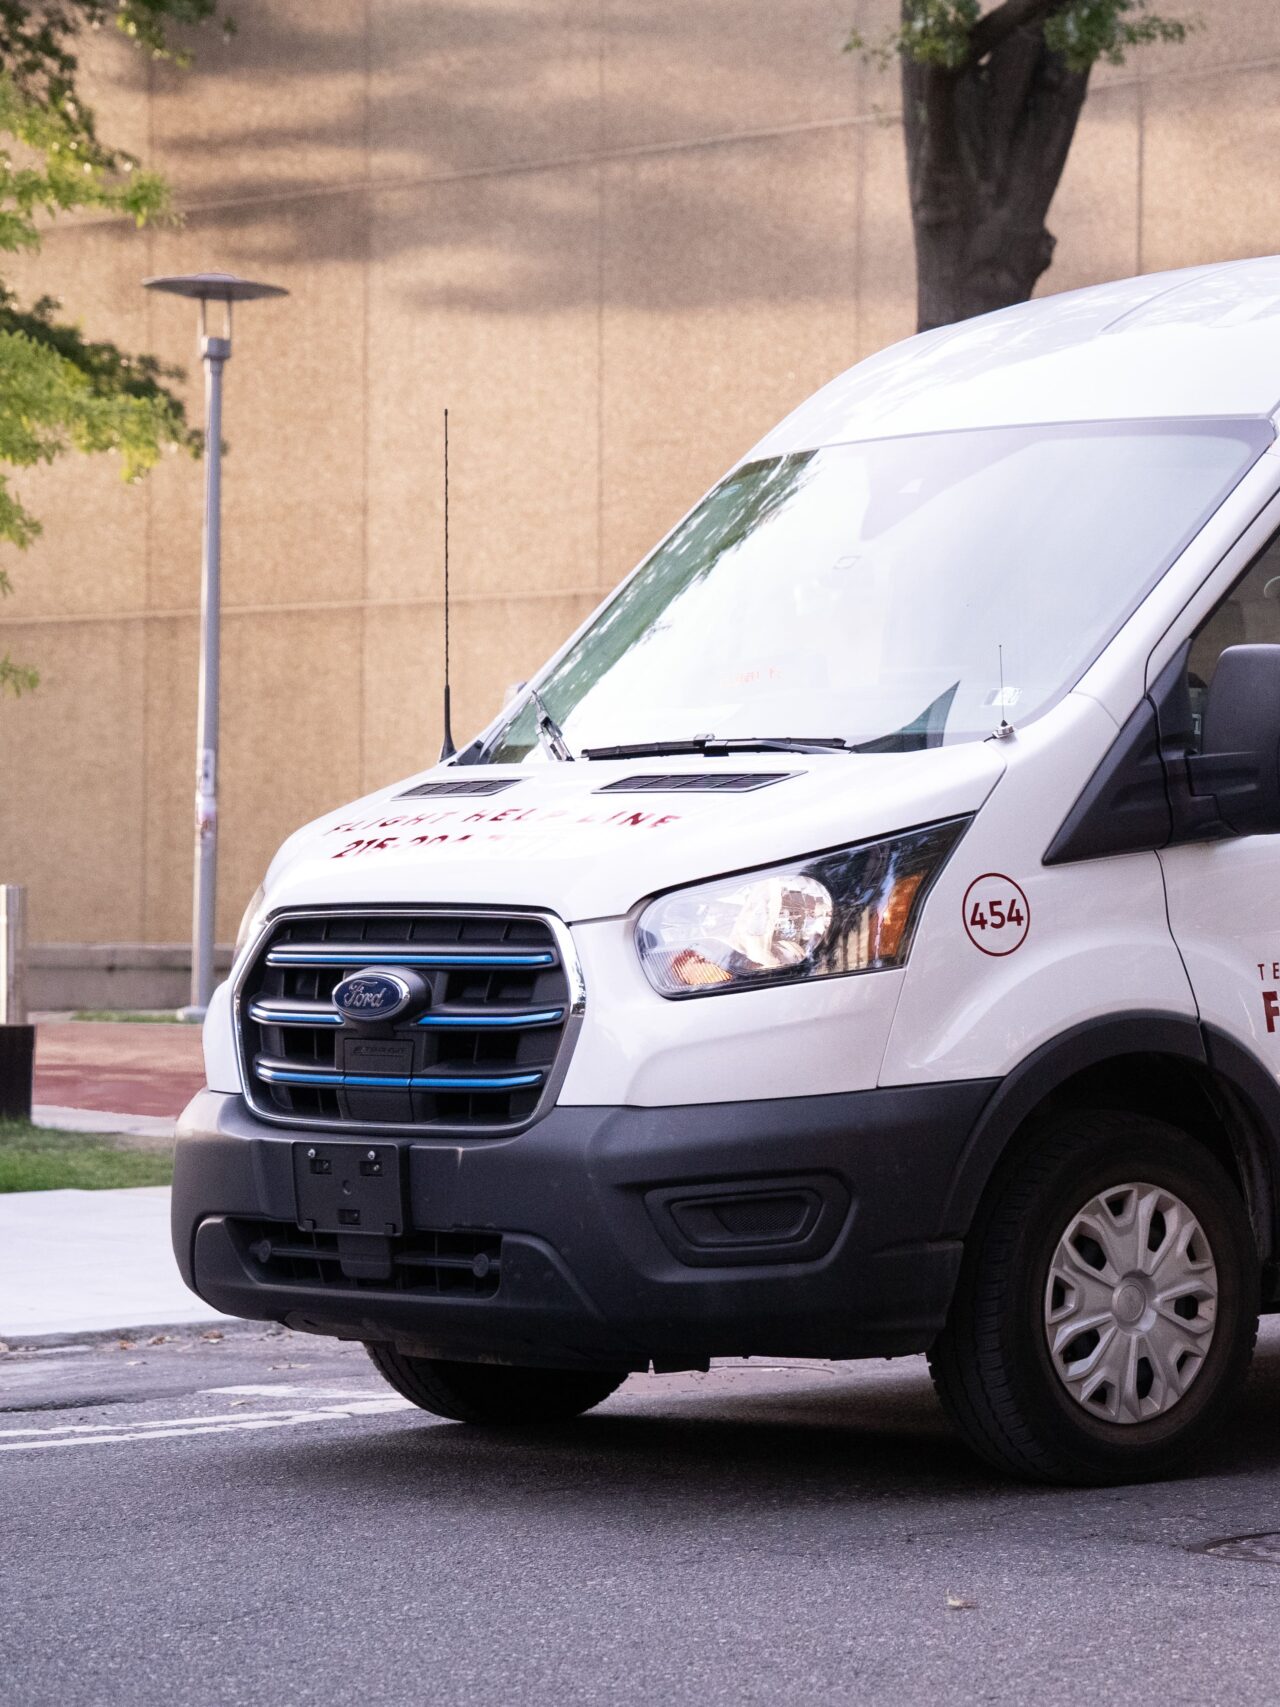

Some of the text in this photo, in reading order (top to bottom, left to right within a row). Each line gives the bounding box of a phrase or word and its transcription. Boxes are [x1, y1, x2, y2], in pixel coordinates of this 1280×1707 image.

[323, 810, 459, 836] FLIGHT
[970, 898, 1024, 930] 454
[343, 979, 387, 1008] Ford
